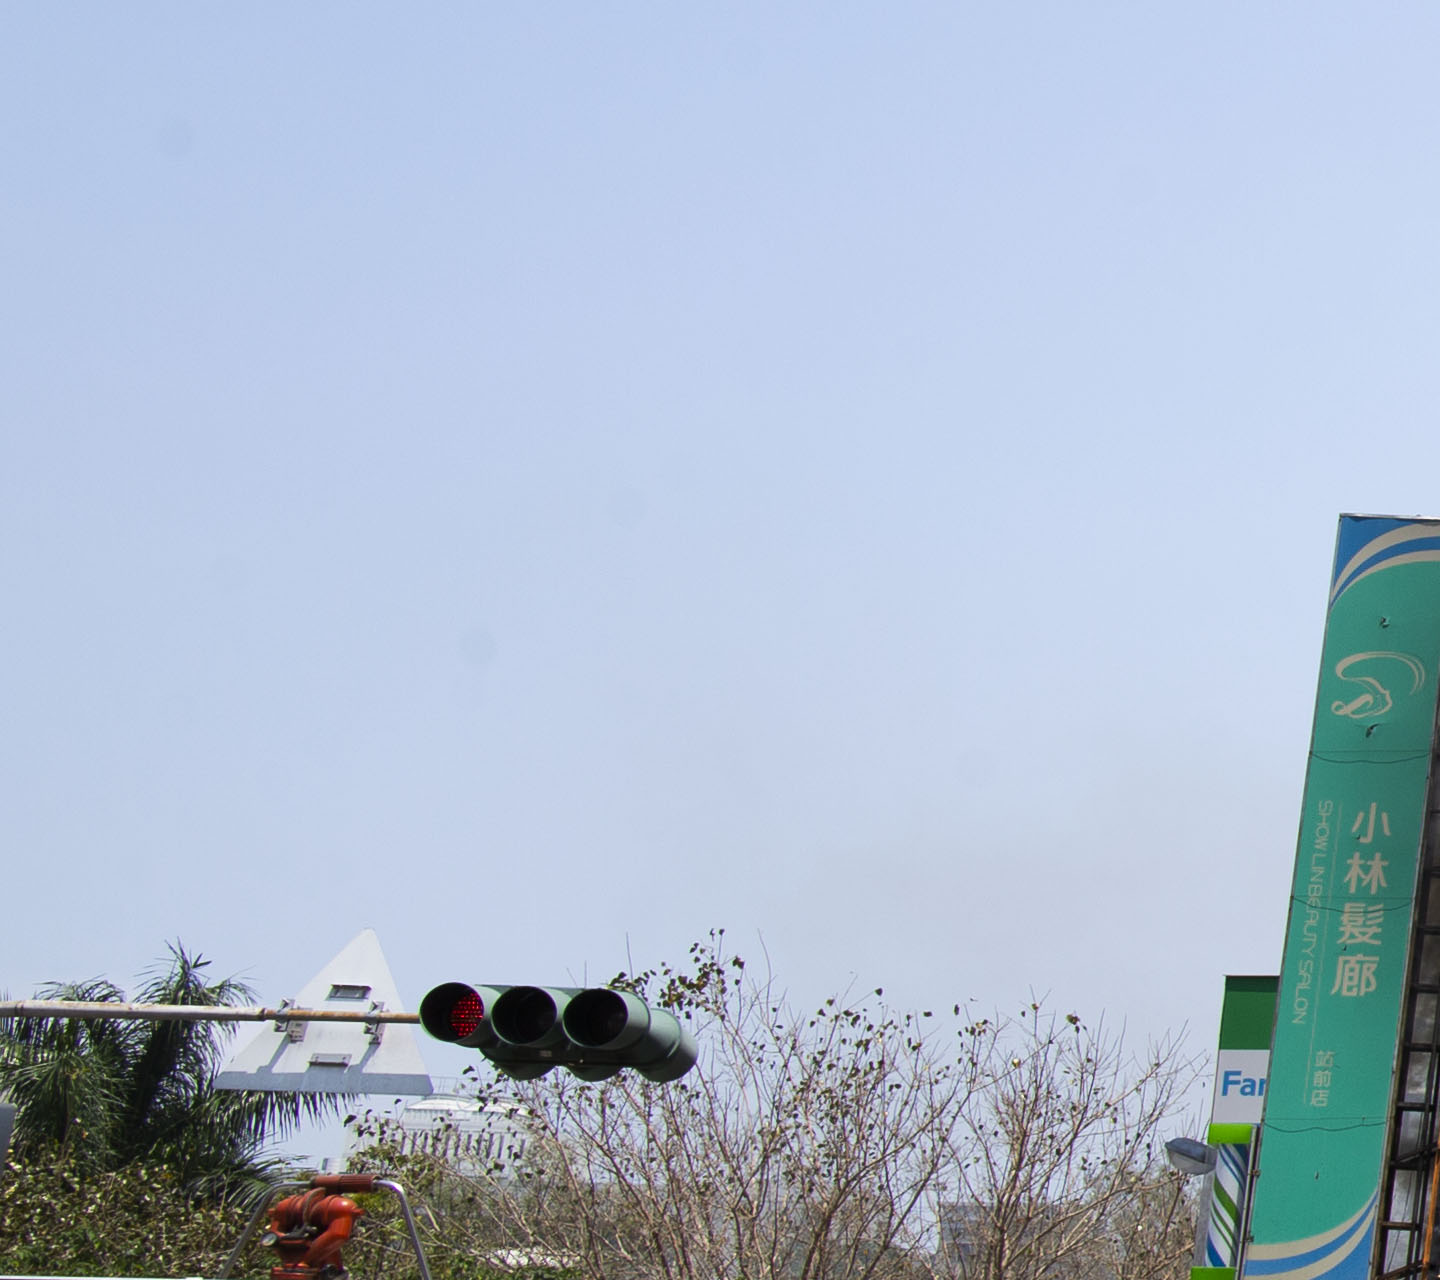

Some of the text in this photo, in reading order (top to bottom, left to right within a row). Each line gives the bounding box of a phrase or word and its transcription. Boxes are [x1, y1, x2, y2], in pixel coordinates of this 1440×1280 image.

[1291, 799, 1333, 1025] SHOW LIN BEAUTY SALON
[1330, 801, 1392, 997] 小林髮廊
[1310, 1050, 1335, 1107] 站前店
